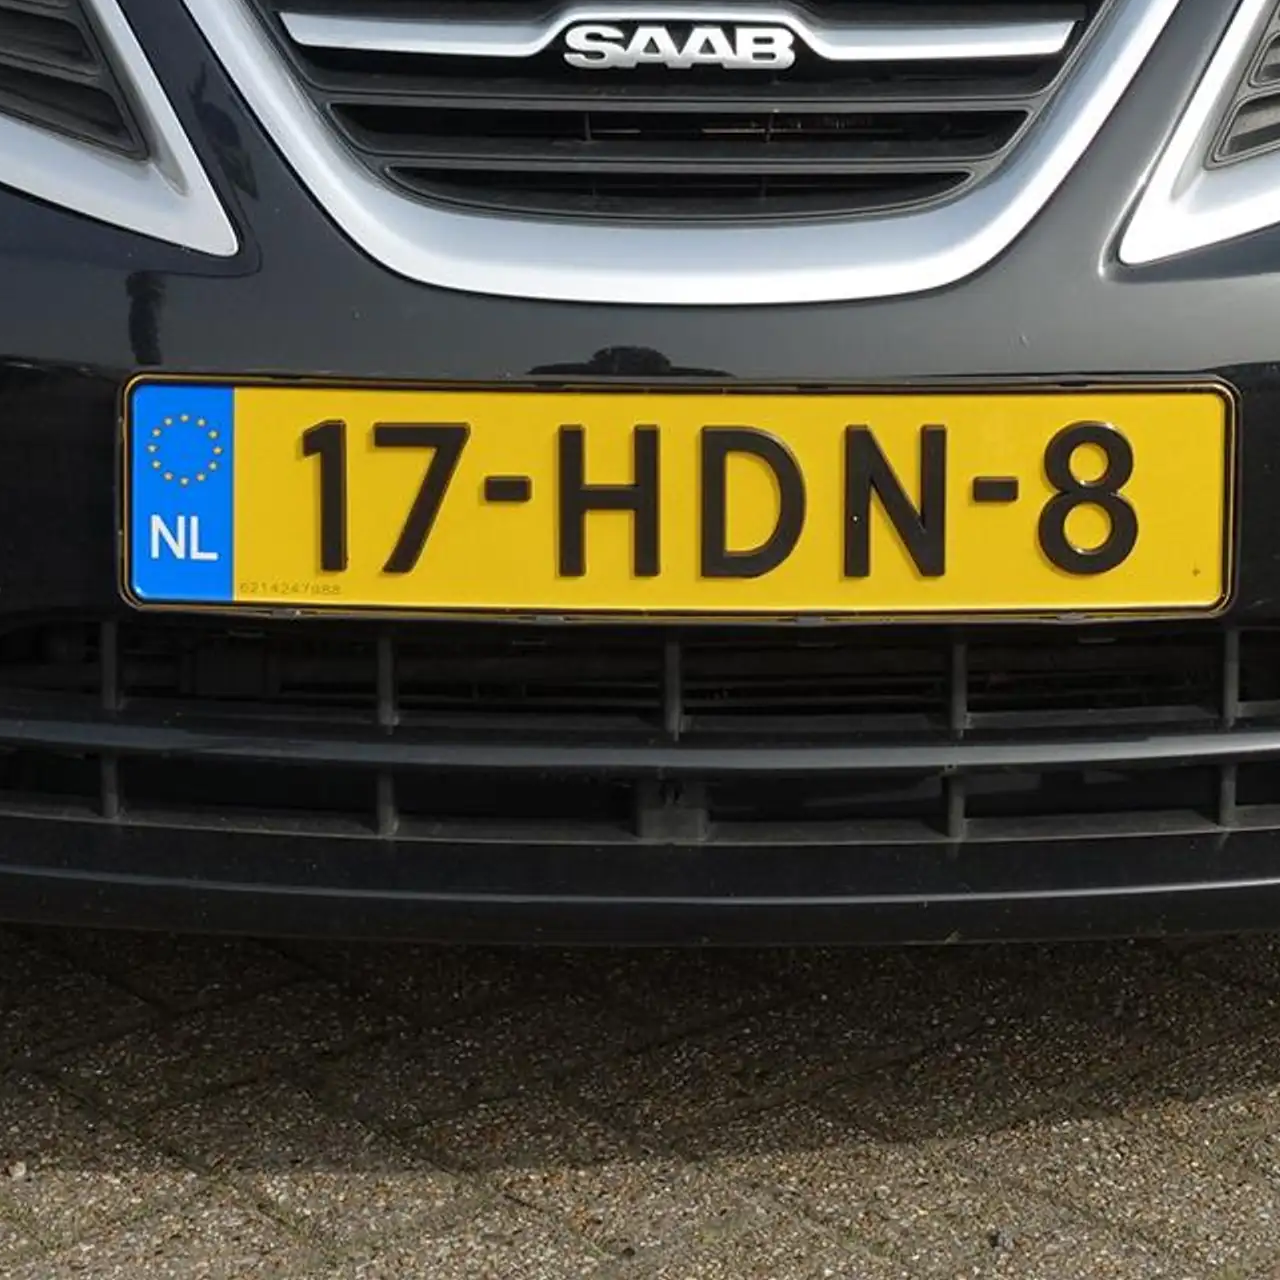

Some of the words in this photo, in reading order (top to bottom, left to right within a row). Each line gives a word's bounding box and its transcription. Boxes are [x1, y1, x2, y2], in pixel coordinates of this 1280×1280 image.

[563, 24, 796, 70] SAAB
[300, 418, 1139, 579] 17-HDN-8
[150, 513, 219, 561] NL
